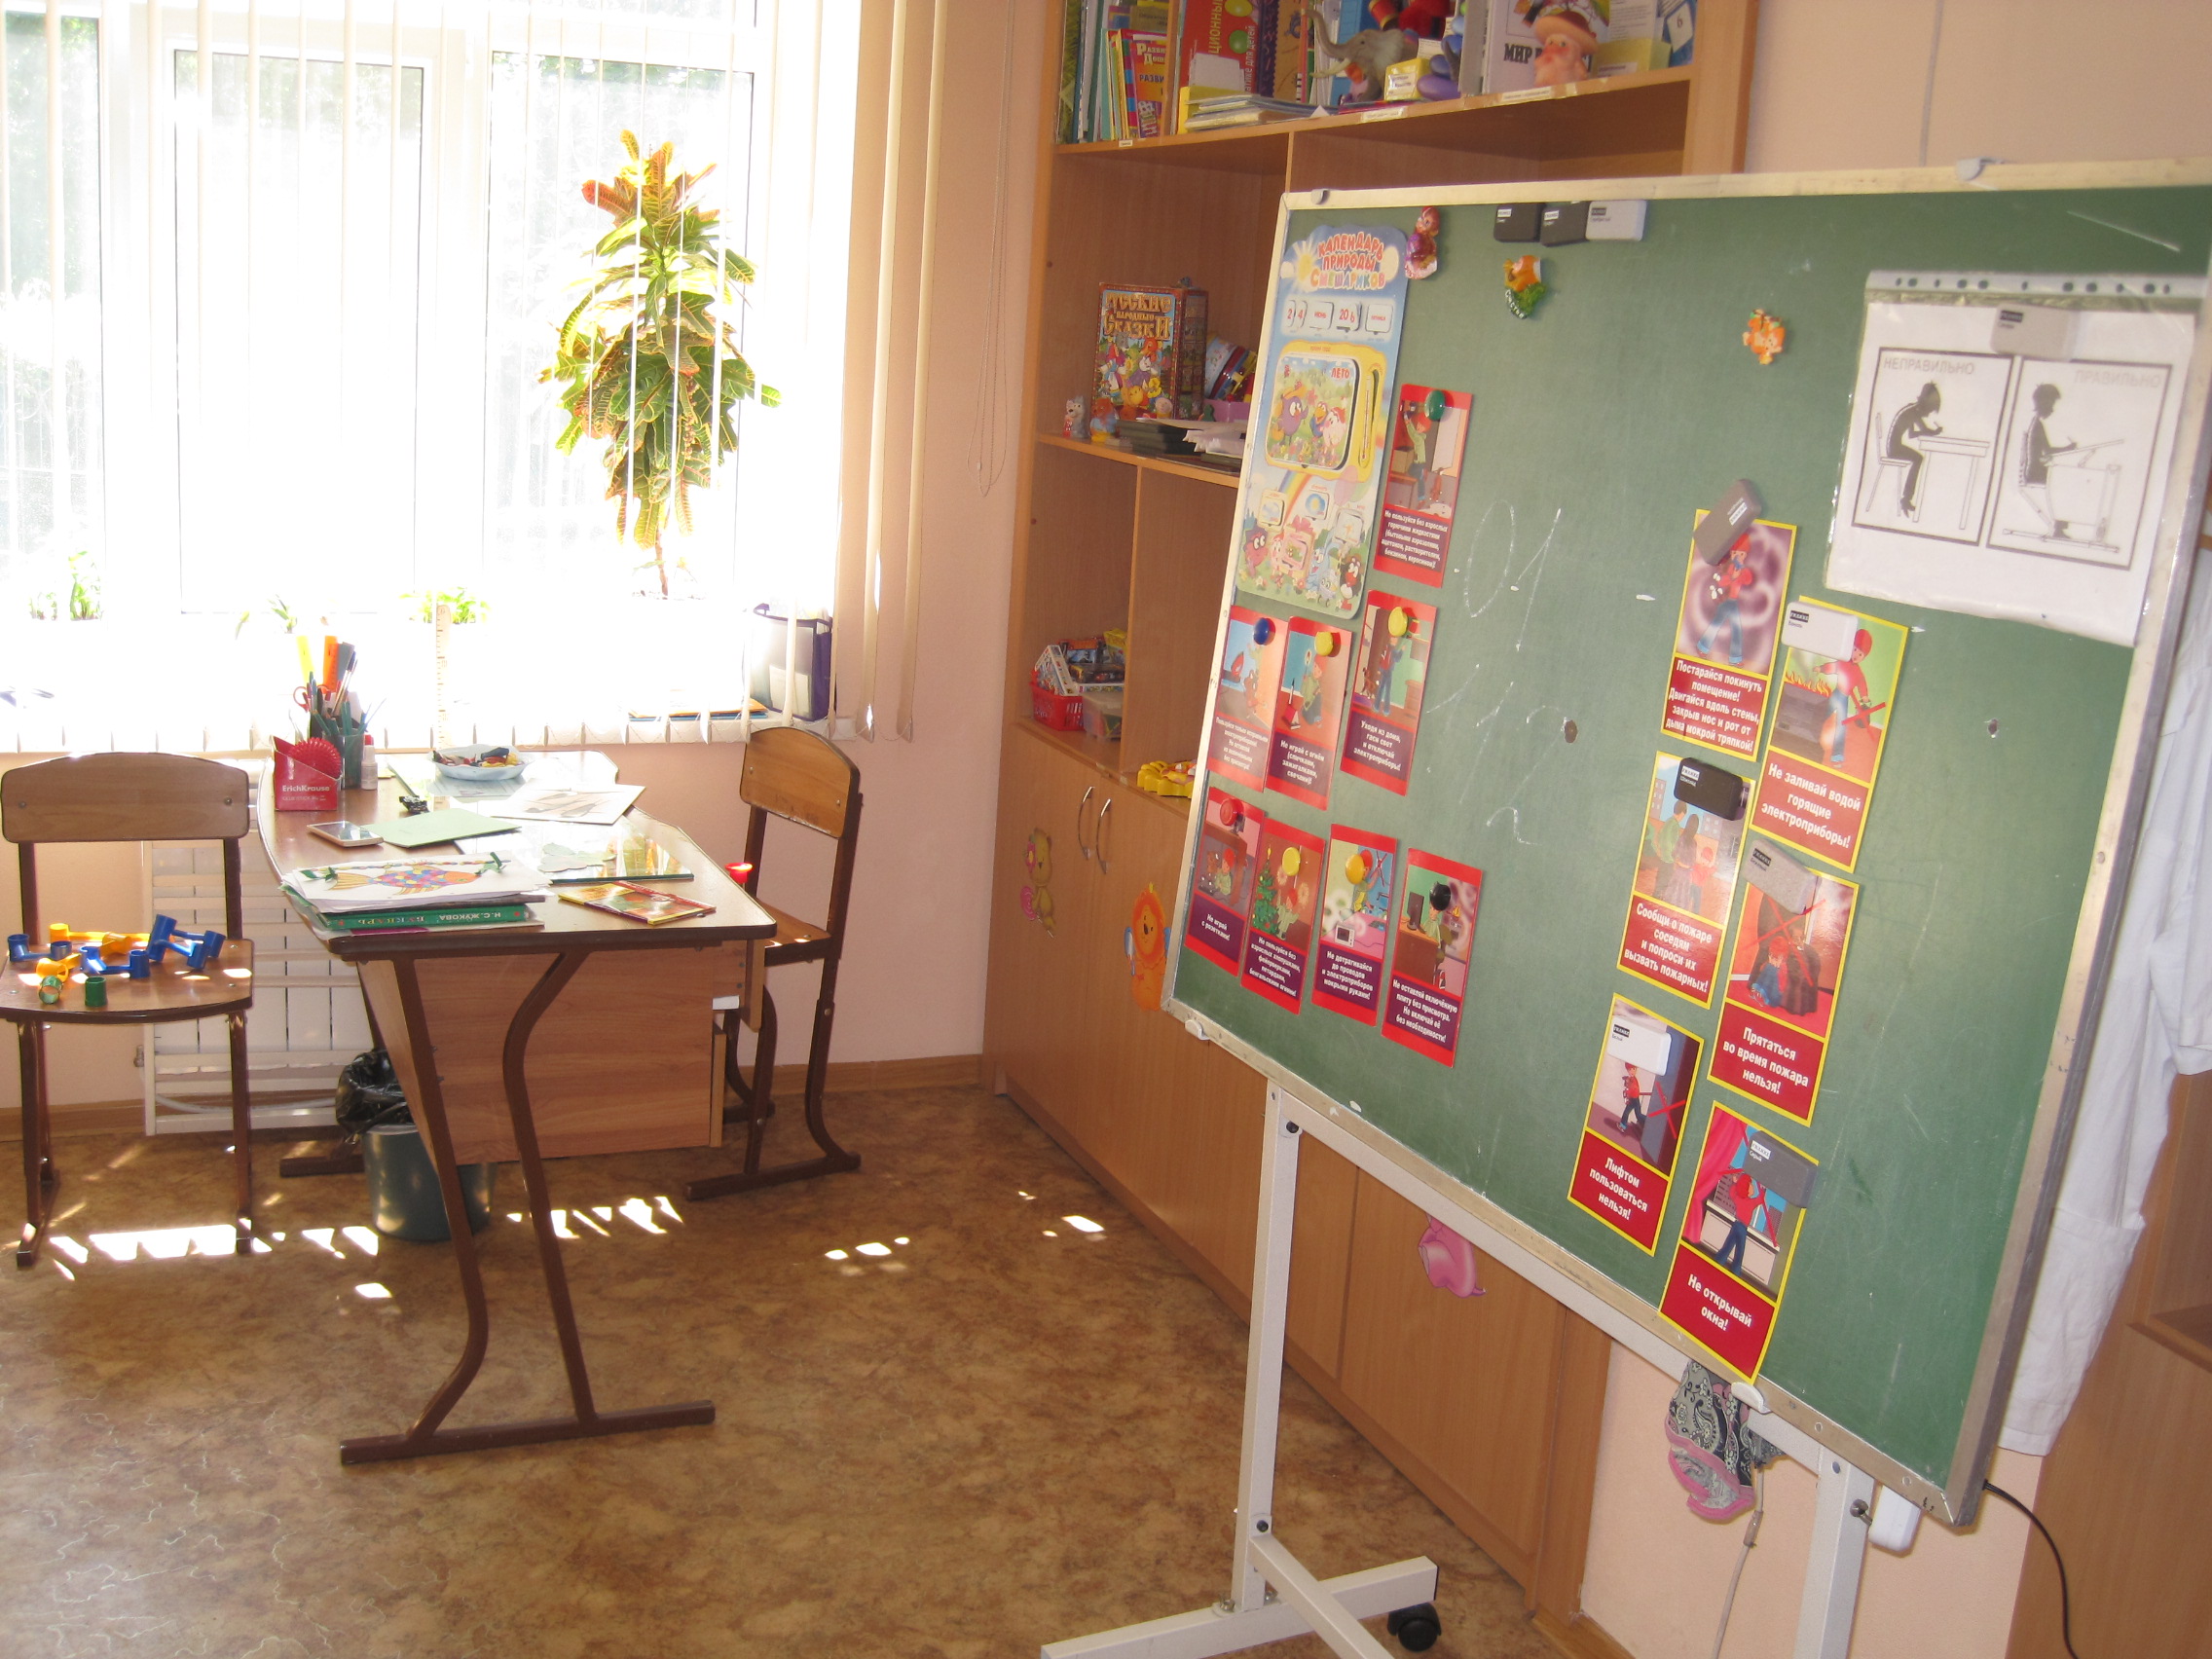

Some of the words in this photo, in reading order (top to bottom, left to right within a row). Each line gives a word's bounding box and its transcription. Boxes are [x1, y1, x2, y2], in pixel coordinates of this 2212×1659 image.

[1245, 25, 1256, 50] детей
[1503, 43, 1532, 64] МИР
[1317, 232, 1384, 262] КАЛЕНДАРЬ
[1323, 253, 1377, 272] ПРИРОДЫ
[1310, 267, 1385, 290] СМЕШАРИКОВ
[1104, 312, 1171, 340] СКАЗКИ
[1331, 367, 1350, 379] ЛЕТО
[1884, 357, 1974, 375] НЕПРАВИЛЬНО
[2074, 370, 2160, 387] ПРАВИЛЬНО
[1677, 659, 1723, 682] Постарайся
[1724, 675, 1762, 692] покинуть
[1691, 681, 1741, 702] помещение!
[1669, 687, 1705, 707] Двигайся
[1706, 700, 1730, 715] вдоль
[1732, 707, 1760, 724] стены,
[1361, 719, 1378, 732] Уходя
[1385, 732, 1401, 743] дома,
[1672, 705, 1700, 720] закрыв
[1701, 715, 1716, 725] нос
[1717, 719, 1724, 727] и
[1724, 720, 1740, 732] рот
[1741, 725, 1751, 736] от
[1280, 740, 1288, 749] Не
[1289, 745, 1305, 755] играй
[1367, 733, 1379, 743] гаси
[1380, 739, 1393, 748] свет
[1666, 718, 1685, 731] дыма
[1685, 724, 1716, 740] мокрой
[1717, 733, 1753, 752] тряпкой!
[1353, 748, 1401, 771] электроприборы!
[1367, 744, 1394, 759] отключай
[1768, 763, 1783, 779] Не
[1784, 772, 1827, 797] заливай
[1828, 790, 1861, 811] водой
[1788, 793, 1831, 820] горящие
[1761, 802, 1851, 849] электроприборы!
[358, 915, 425, 925] БУКВАРЬ
[1637, 903, 1671, 927] Сообщи
[1672, 919, 1677, 928] о
[1678, 923, 1713, 943] пожаре
[1653, 929, 1690, 951] соседям
[1641, 940, 1647, 949] и
[1648, 943, 1683, 966] попроси
[1685, 958, 1697, 972] их
[1624, 948, 1659, 972] вызвать
[1660, 965, 1709, 993] пожарных!
[1393, 978, 1400, 989] Не
[1401, 984, 1424, 1000] оставляй
[1396, 993, 1412, 1006] плиту
[1412, 998, 1421, 1010] без
[1396, 1014, 1406, 1024] без
[1403, 1006, 1411, 1015] Не
[1411, 1011, 1433, 1026] включай
[1743, 1026, 1796, 1061] Прятаться
[1723, 1041, 1736, 1053] во
[1737, 1048, 1768, 1069] время
[1769, 1061, 1809, 1088] пожара
[1742, 1069, 1782, 1094] нельзя!
[1604, 1157, 1641, 1189] Лифтом
[1589, 1168, 1648, 1212] пользоваться
[1598, 1193, 1631, 1221] нельзя!
[1687, 1273, 1702, 1292] Не
[1703, 1287, 1752, 1328] открывай
[1701, 1307, 1729, 1332] окна!
